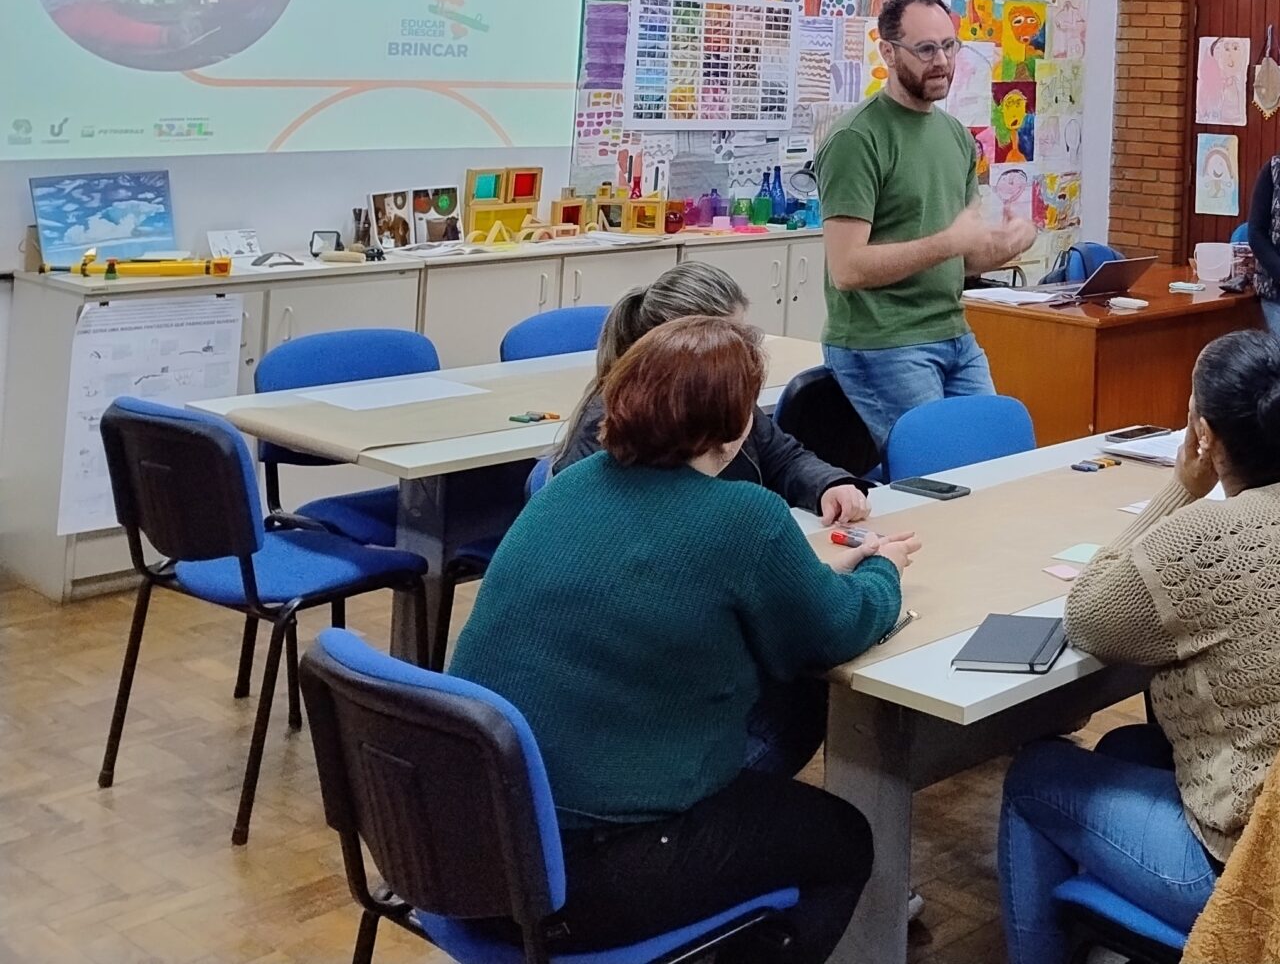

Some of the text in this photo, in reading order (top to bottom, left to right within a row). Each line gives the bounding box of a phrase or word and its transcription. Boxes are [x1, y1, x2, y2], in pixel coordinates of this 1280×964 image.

[401, 19, 445, 29] EDUCAR
[401, 28, 445, 37] CRESCER
[387, 42, 468, 58] BRINCAR
